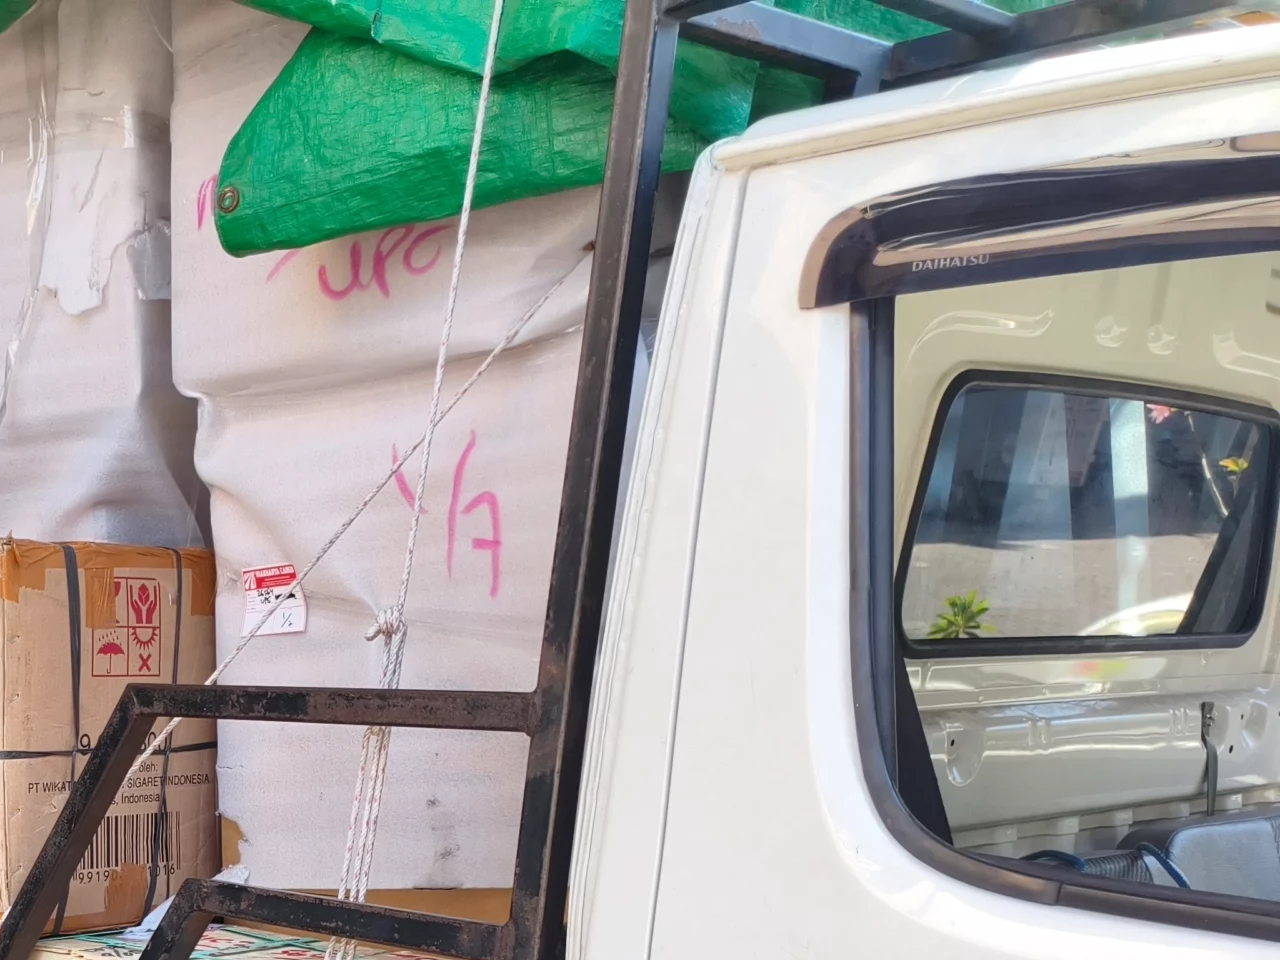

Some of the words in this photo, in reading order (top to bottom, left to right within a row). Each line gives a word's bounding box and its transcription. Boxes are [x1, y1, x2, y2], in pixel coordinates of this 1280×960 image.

[911, 254, 990, 272] DAIHATSU
[28, 782, 40, 794] PT
[121, 793, 160, 804] Indonesia
